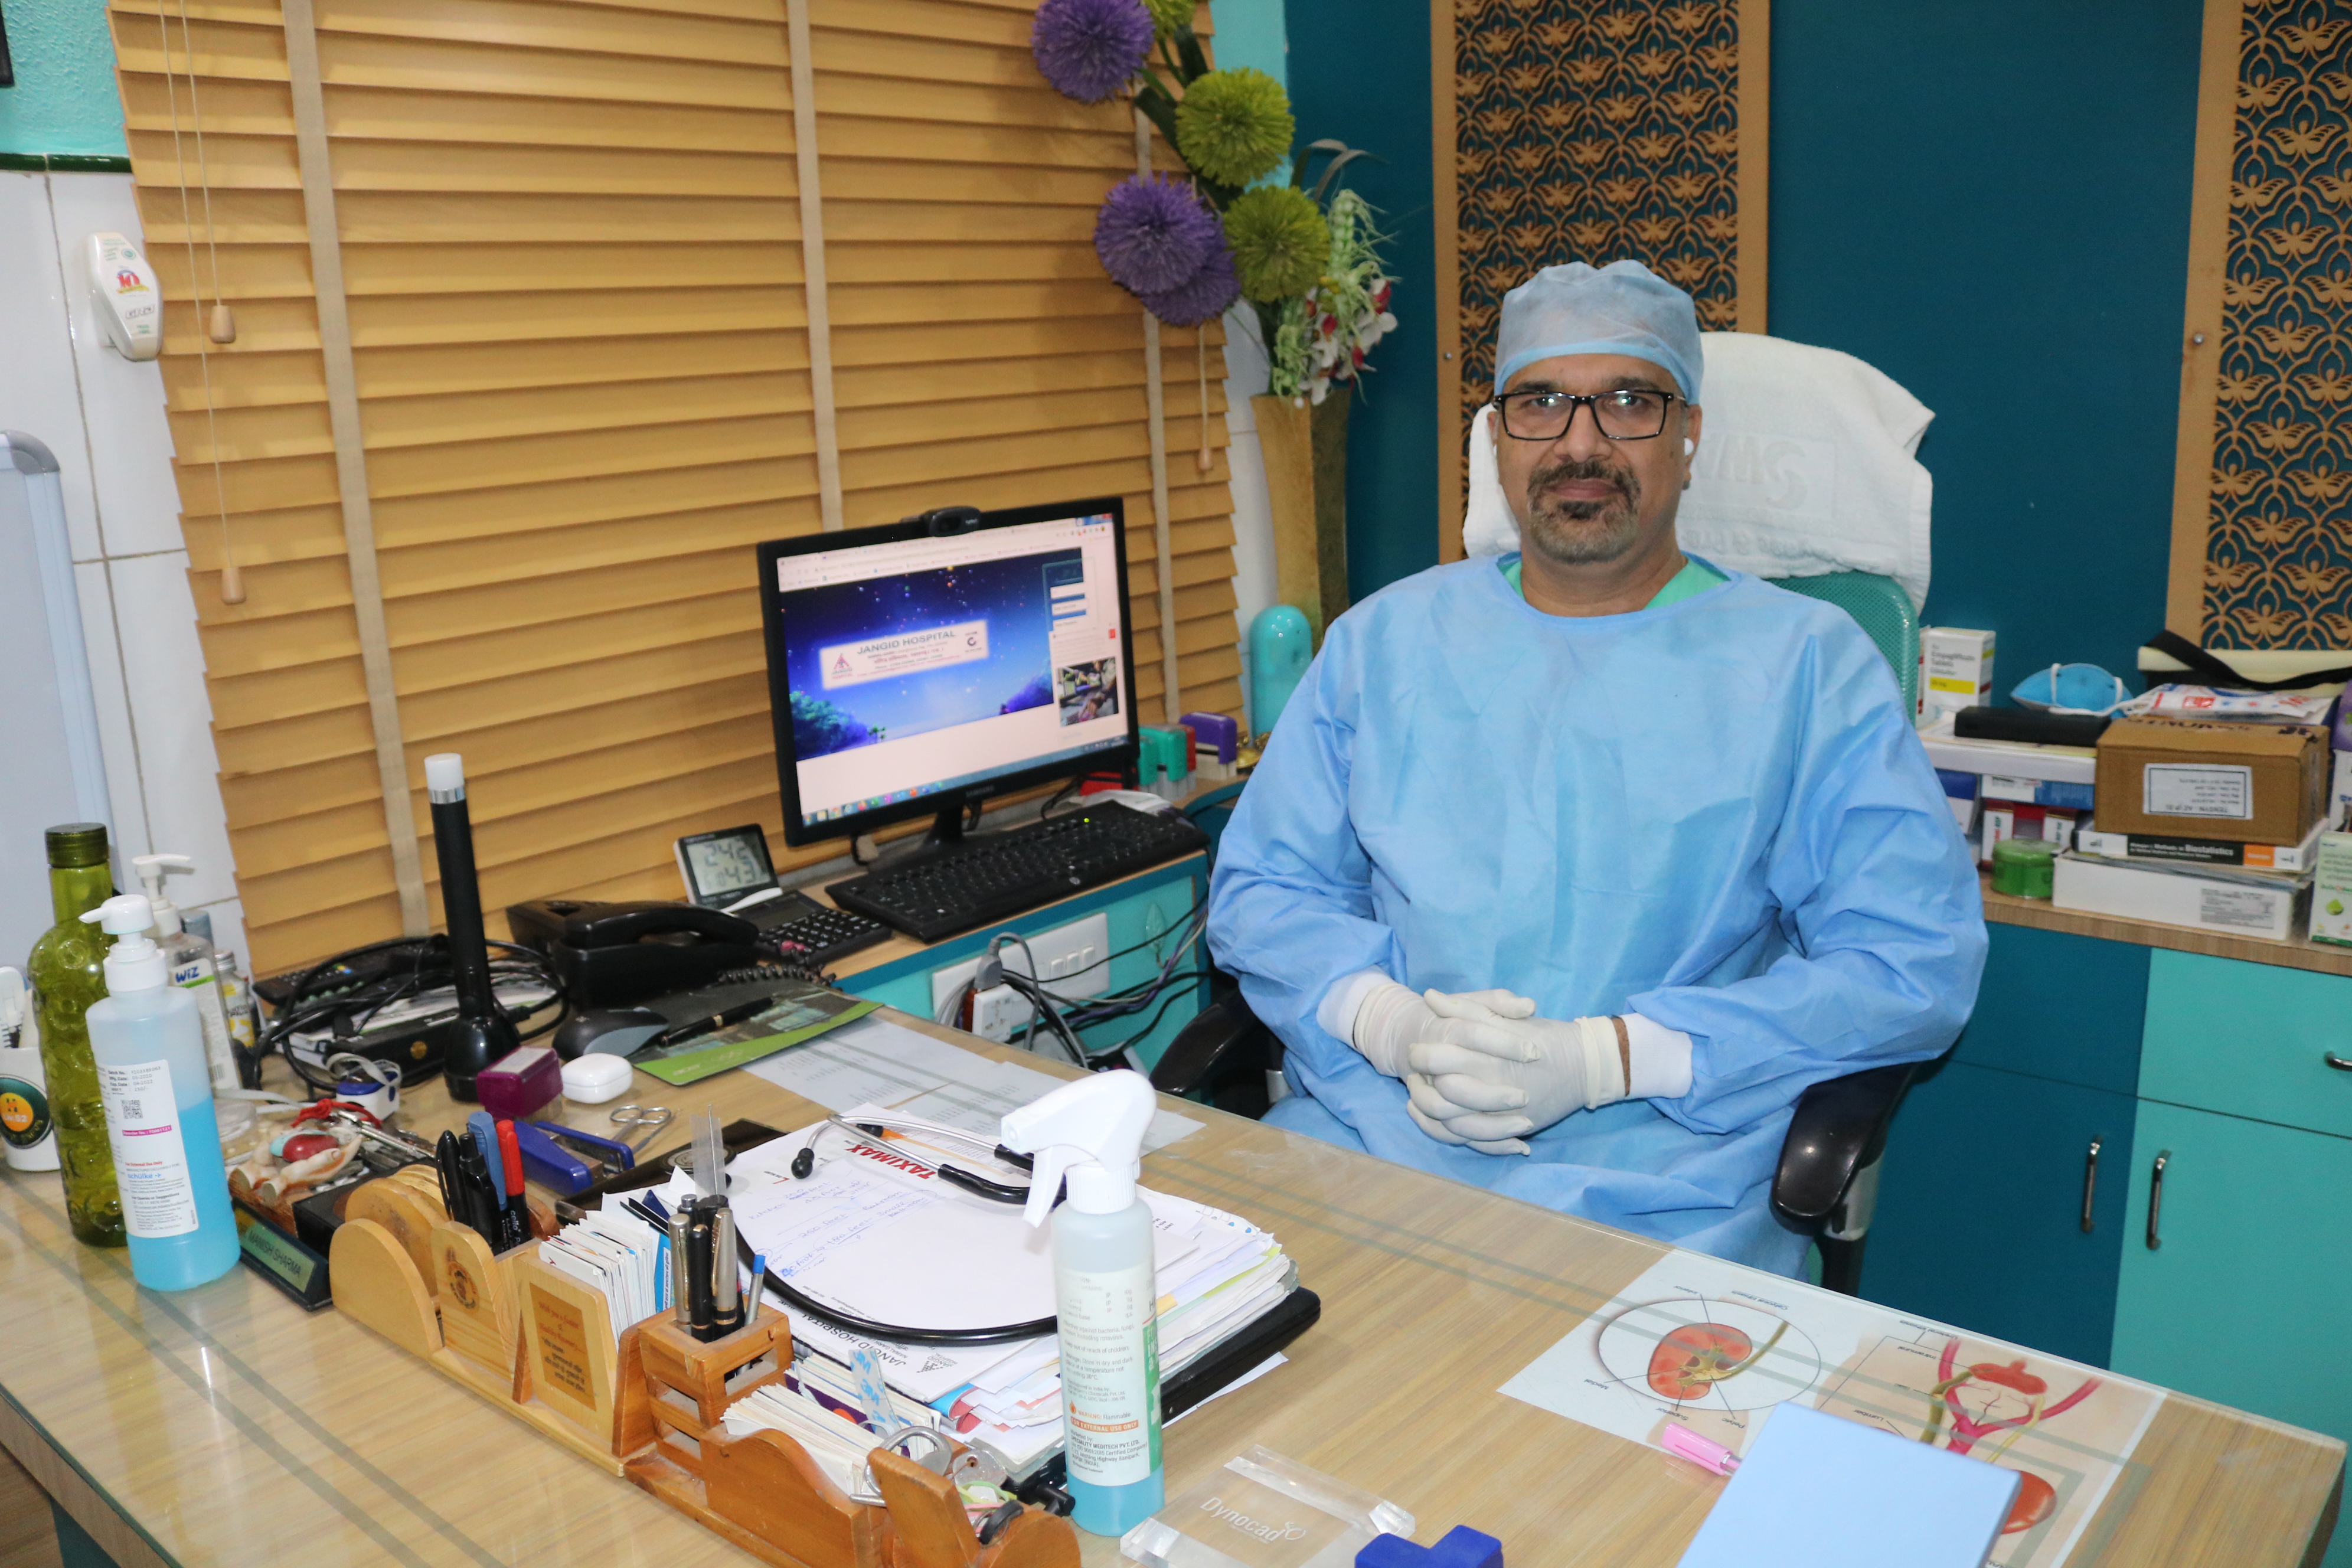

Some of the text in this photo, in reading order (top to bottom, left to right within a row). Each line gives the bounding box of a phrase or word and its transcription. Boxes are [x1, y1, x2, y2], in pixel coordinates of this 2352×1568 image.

[857, 640, 899, 655] JANGID
[903, 631, 955, 646] HOSPITAL
[844, 1144, 936, 1180] TAXIMAX
[273, 1249, 302, 1276] SHARMA
[1079, 1325, 1097, 1334] against
[1077, 1333, 1099, 1341] including
[935, 1353, 958, 1365] HOSPITAL
[1897, 1345, 1937, 1360] Intramural
[927, 1355, 952, 1367] JANGID
[1583, 1378, 1610, 1390] Medial
[1078, 1410, 1102, 1420] WARNING:
[1655, 1406, 1689, 1422] Superior
[1854, 1409, 1884, 1422] Lumbar
[1072, 1418, 1080, 1426] FOR
[1081, 1422, 1109, 1432] EXTERNAL
[1123, 1422, 1137, 1430] ONLY
[1721, 1417, 1746, 1430] Pelvic
[1070, 1429, 1086, 1440] Marketed
[1071, 1435, 1092, 1448] SPECIALITY
[1083, 1446, 1105, 1455] 9001:2015
[1126, 1442, 1148, 1452] Company)
[1072, 1453, 1100, 1468] JAIPUR (INDIA).
[1200, 1497, 1286, 1541] Dynocad
